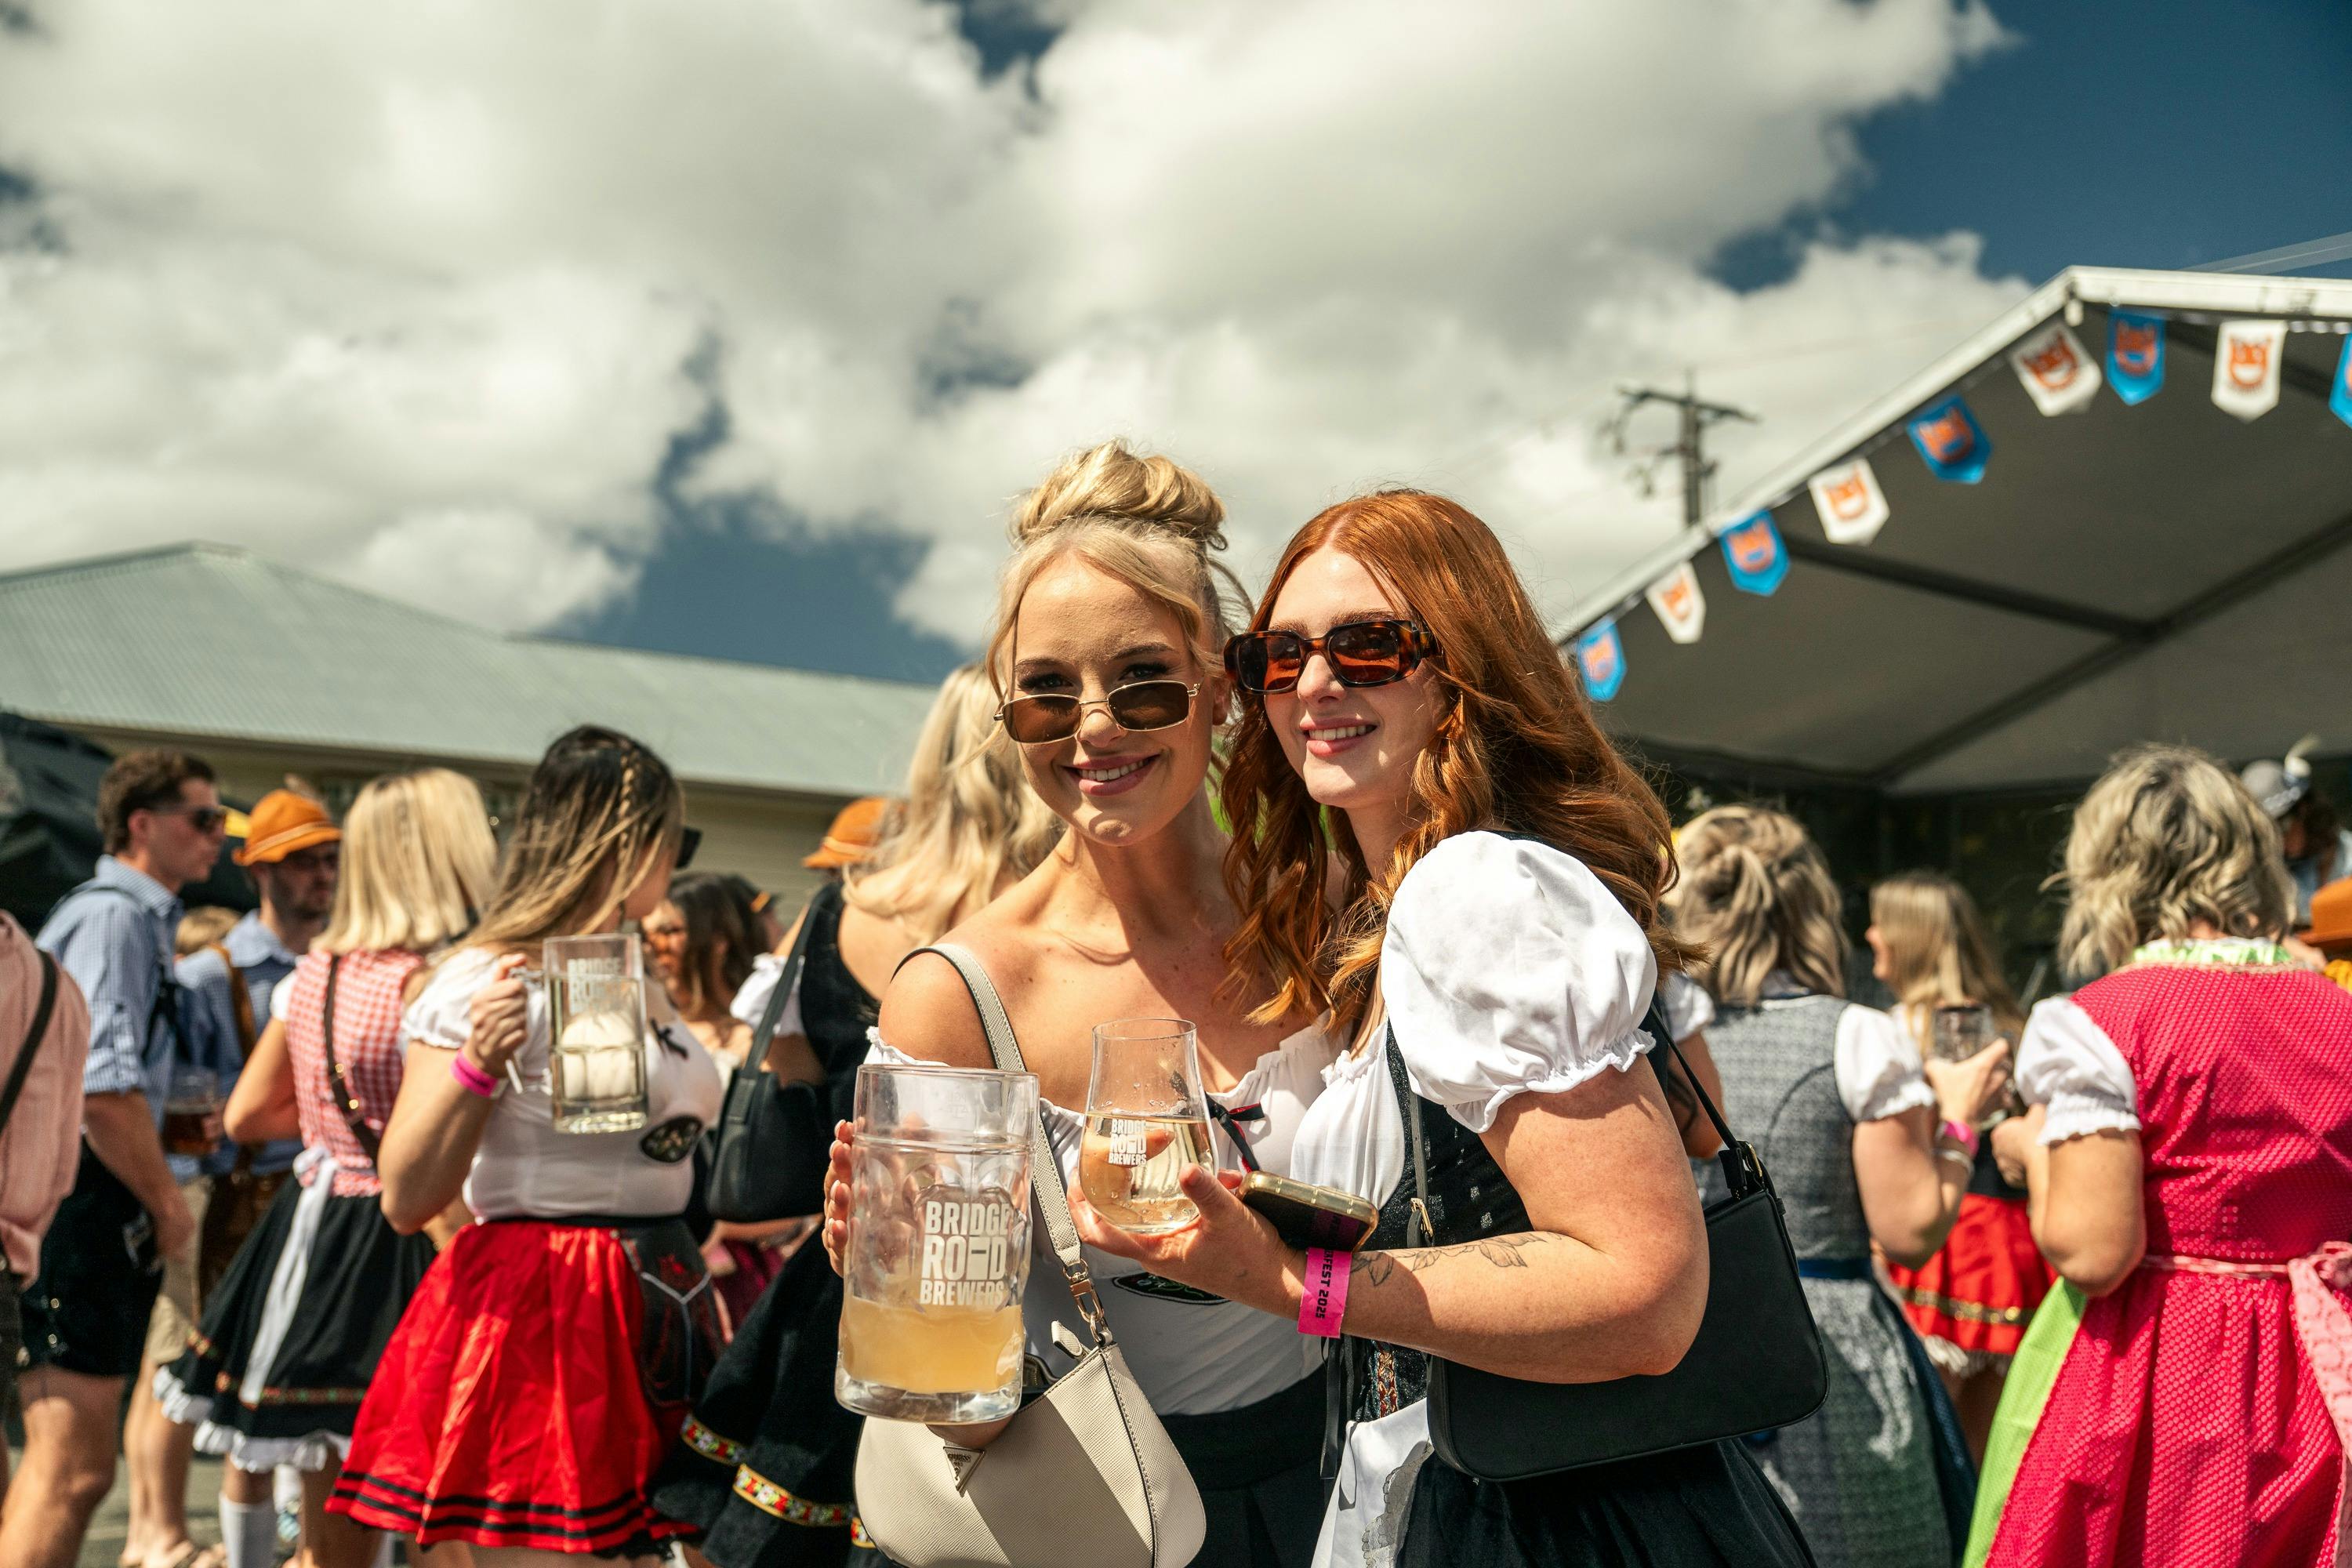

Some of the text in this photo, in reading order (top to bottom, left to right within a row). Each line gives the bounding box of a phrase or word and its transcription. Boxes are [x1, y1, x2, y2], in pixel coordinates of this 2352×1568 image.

[1109, 1152, 1147, 1165] BREWERS
[925, 1200, 1014, 1236] BRIDGE
[920, 1279, 1004, 1306] BREWERS
[1316, 1289, 1329, 1319] 2025
